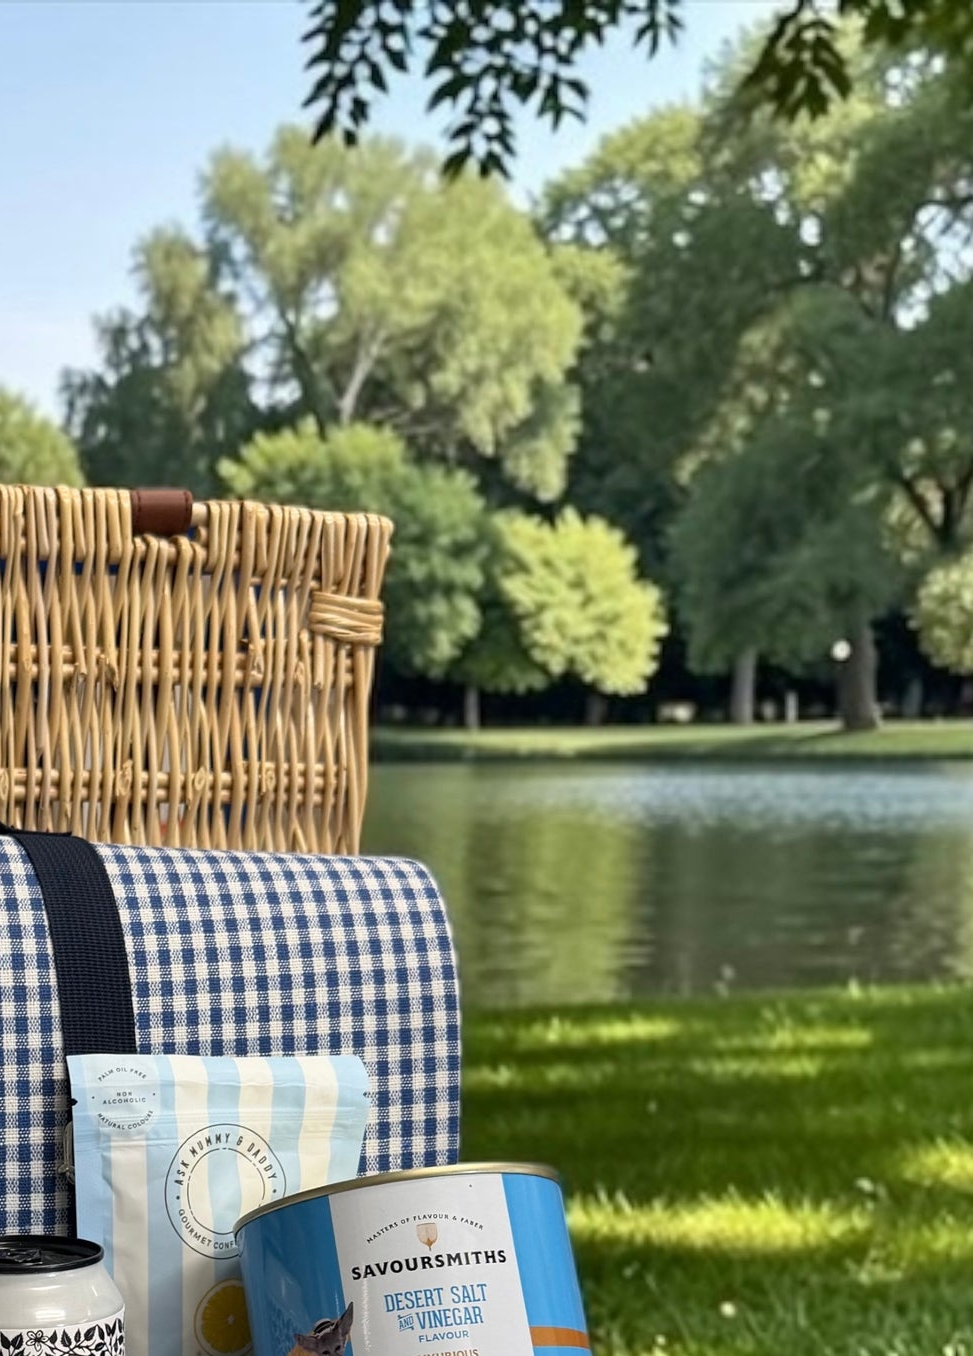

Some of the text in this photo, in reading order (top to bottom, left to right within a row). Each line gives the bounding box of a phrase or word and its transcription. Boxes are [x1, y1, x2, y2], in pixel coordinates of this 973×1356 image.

[98, 1069, 114, 1081] PALM
[130, 1068, 147, 1079] FREE
[102, 1097, 146, 1105] ALCOHOLIC
[97, 1110, 154, 1130] NATURAL COLOURS
[174, 1160, 190, 1186] ASK
[189, 1133, 230, 1157] MUMMY
[247, 1142, 278, 1180] DADDY
[178, 1208, 212, 1247] GOURMET
[367, 1221, 398, 1244] MASTERS
[401, 1217, 410, 1225] OF
[413, 1213, 449, 1221] FLAVOUR
[460, 1217, 484, 1230] FABER
[351, 1250, 507, 1280] SAVOURSMITHS
[384, 1283, 488, 1313] DESERT SALT
[399, 1306, 484, 1330] AND VINEGAR
[418, 1330, 469, 1343] FLAVOUR
